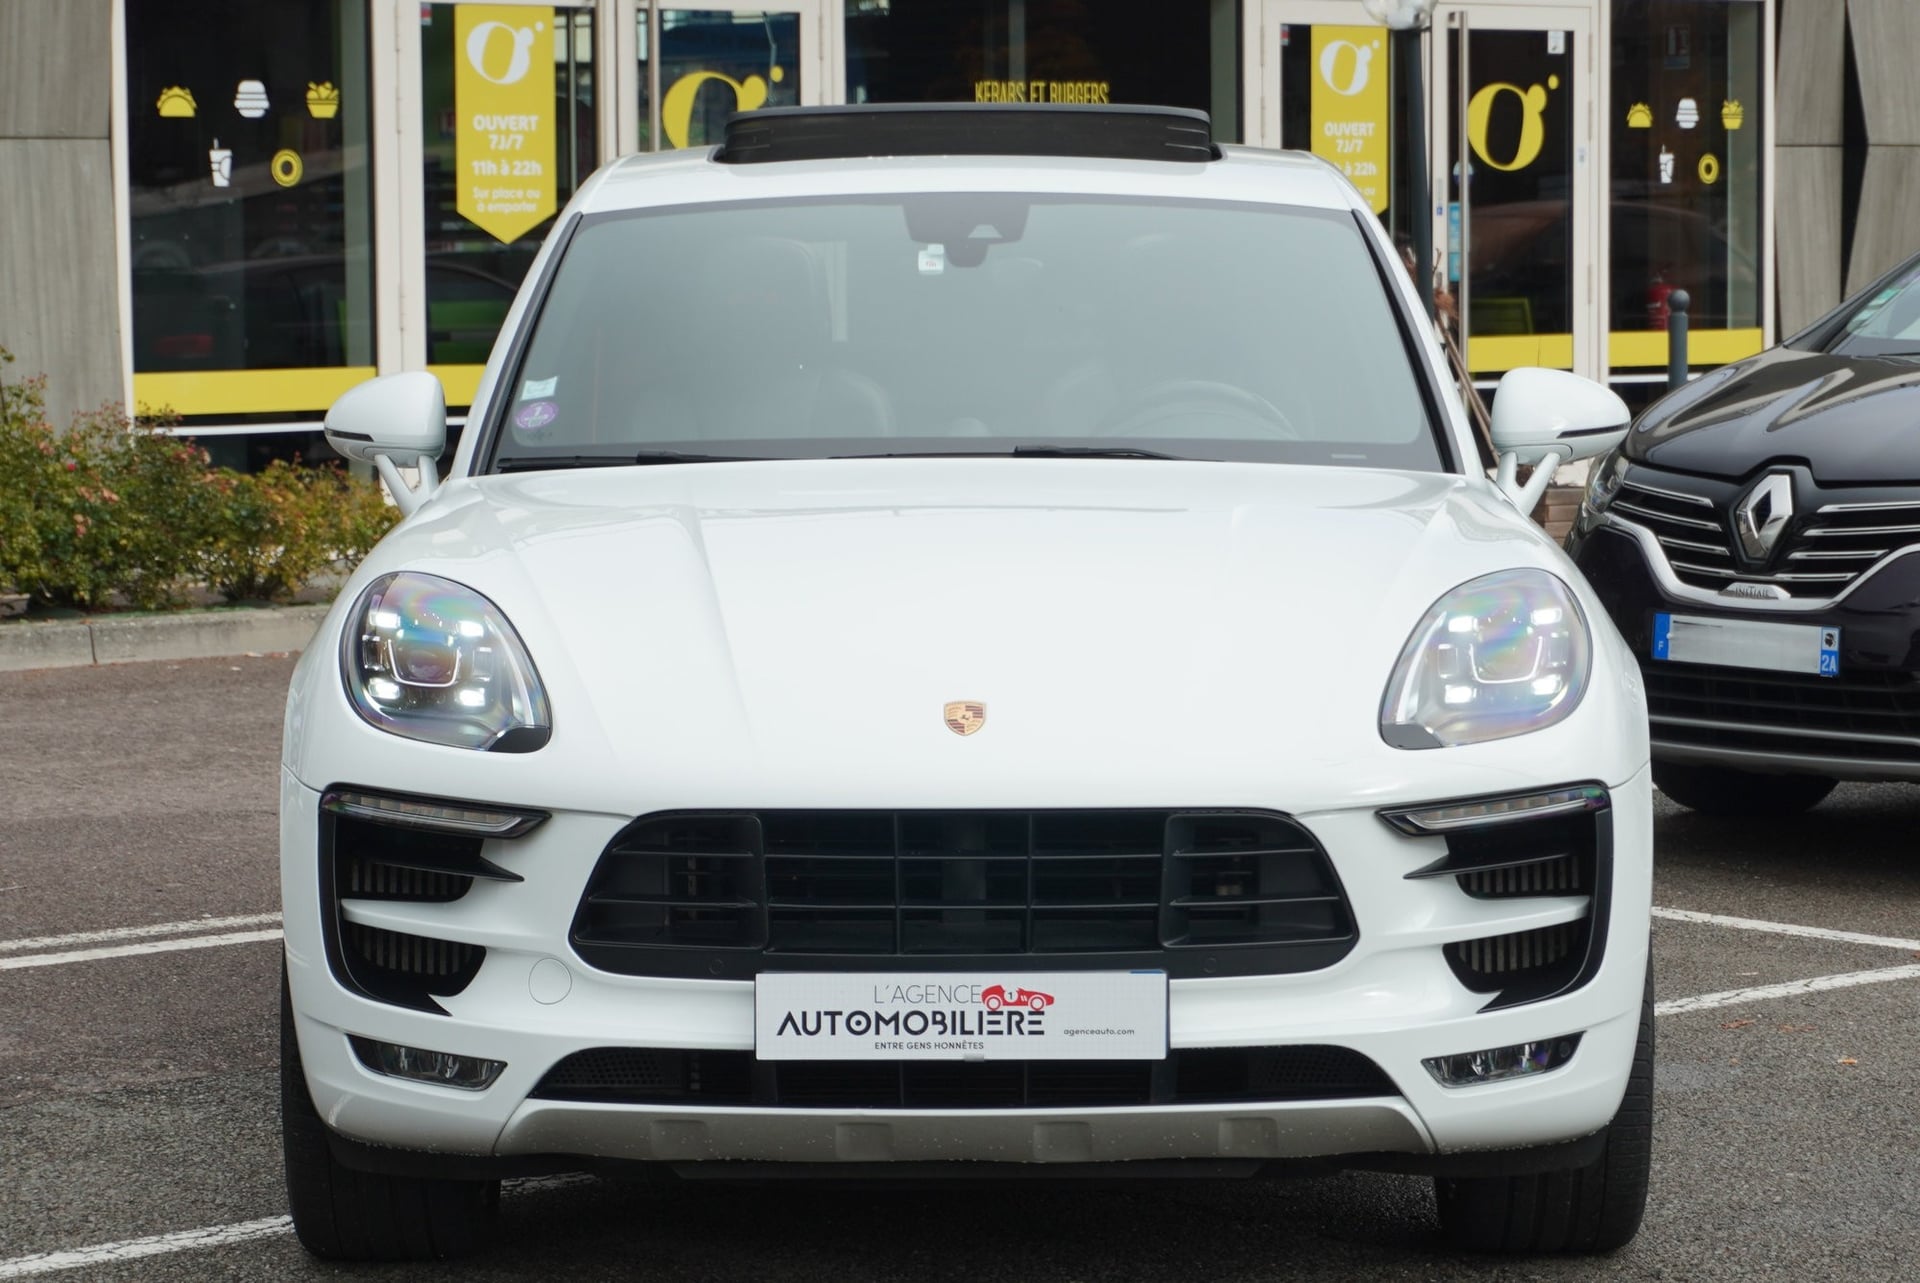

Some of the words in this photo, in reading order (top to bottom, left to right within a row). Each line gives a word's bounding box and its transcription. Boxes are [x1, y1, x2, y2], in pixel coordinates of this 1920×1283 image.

[1049, 82, 1110, 104] BURGERS
[473, 114, 538, 132] OUVERT
[1324, 121, 1375, 137] OUVERT
[472, 160, 497, 176] 11h
[501, 159, 510, 176] à
[513, 160, 542, 176] 22h
[1355, 162, 1377, 176] 22h
[492, 187, 524, 201] place
[487, 202, 538, 215] emporter
[1658, 640, 1664, 651] F
[1821, 654, 1838, 673] 2A
[874, 984, 982, 1004] L'AGENCE
[1063, 1026, 1135, 1036] agenceauto.com
[874, 1041, 904, 1050] ENTRE
[906, 1041, 932, 1050] GENS
[934, 1040, 984, 1050] HONNÊTES
